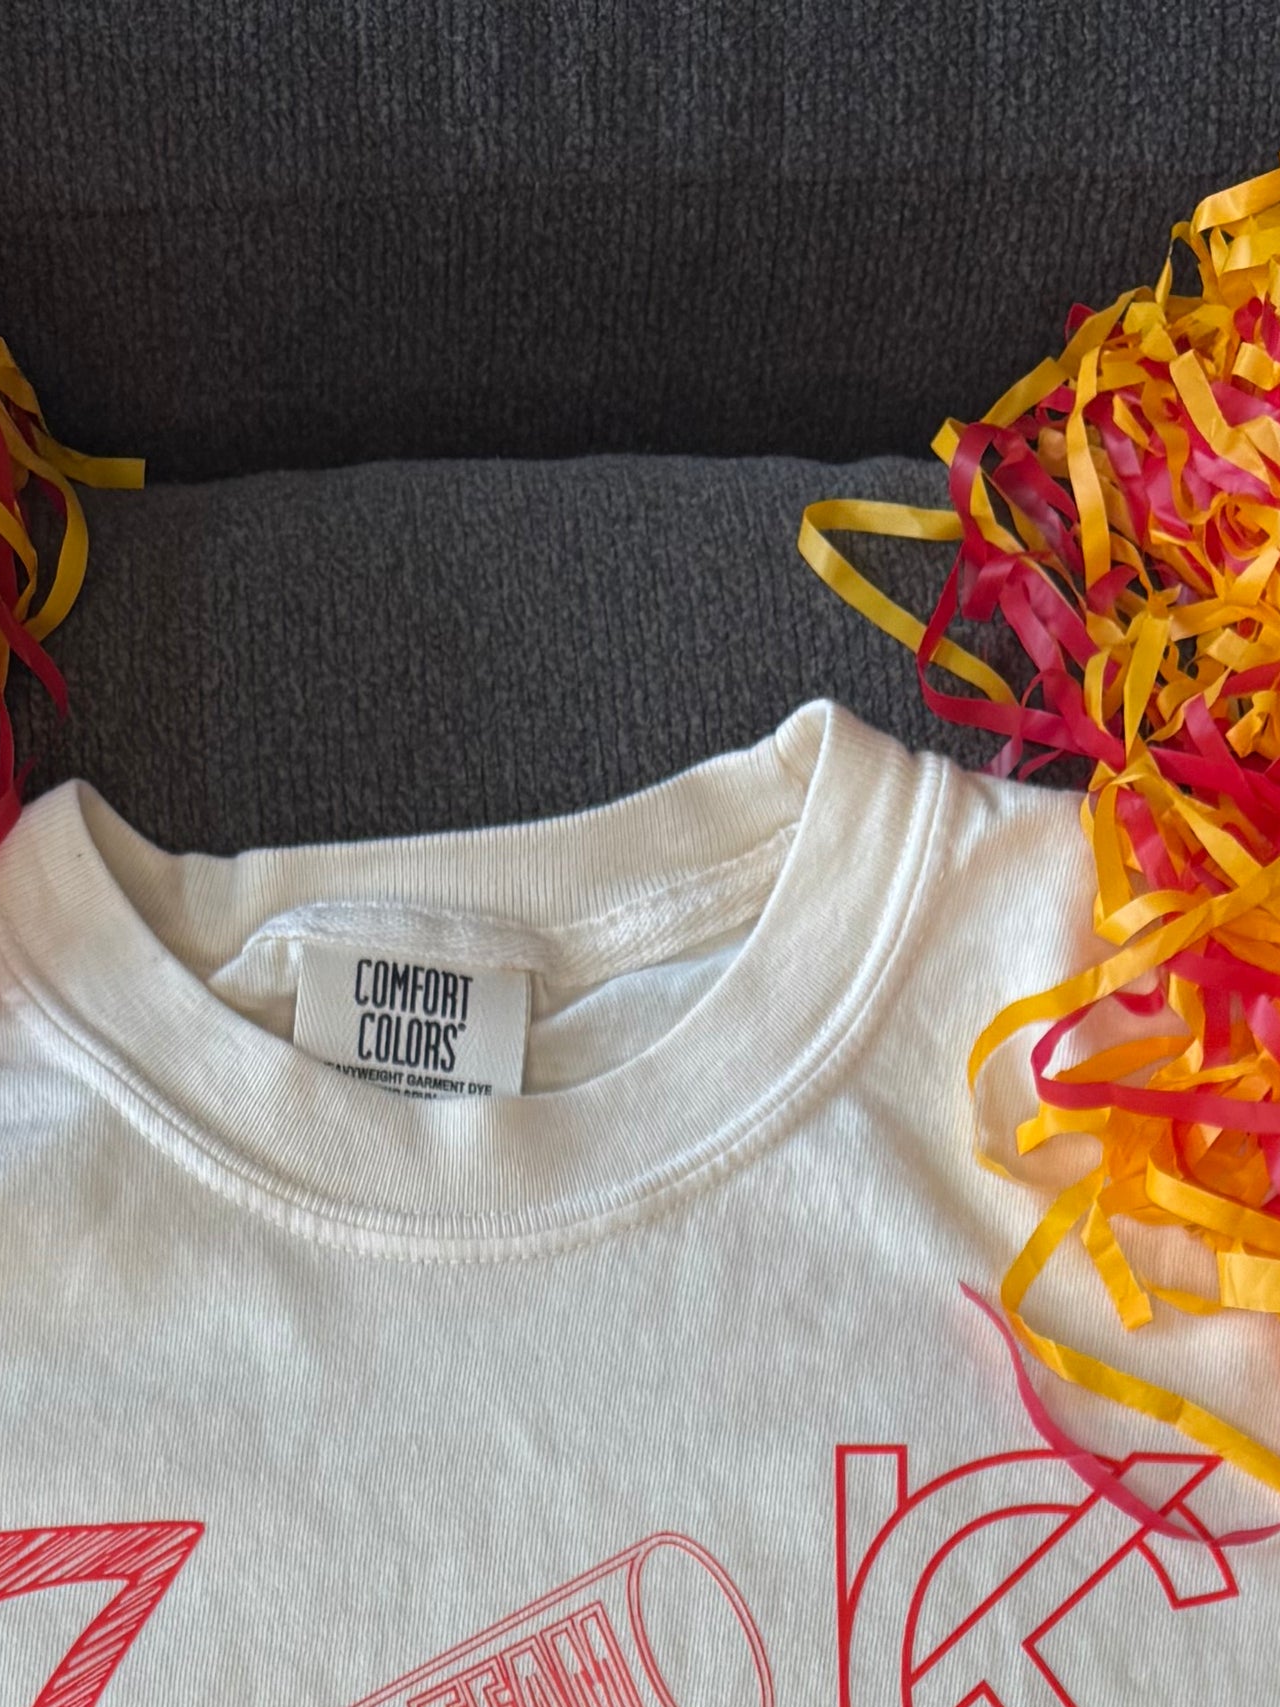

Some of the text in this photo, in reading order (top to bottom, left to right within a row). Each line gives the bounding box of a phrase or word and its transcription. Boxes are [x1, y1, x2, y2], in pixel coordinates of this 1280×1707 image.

[355, 959, 473, 1021] COMFORT
[323, 1061, 403, 1086] AVYWEIGHT
[406, 1073, 465, 1094] GARMENT
[468, 1082, 492, 1096] DYE
